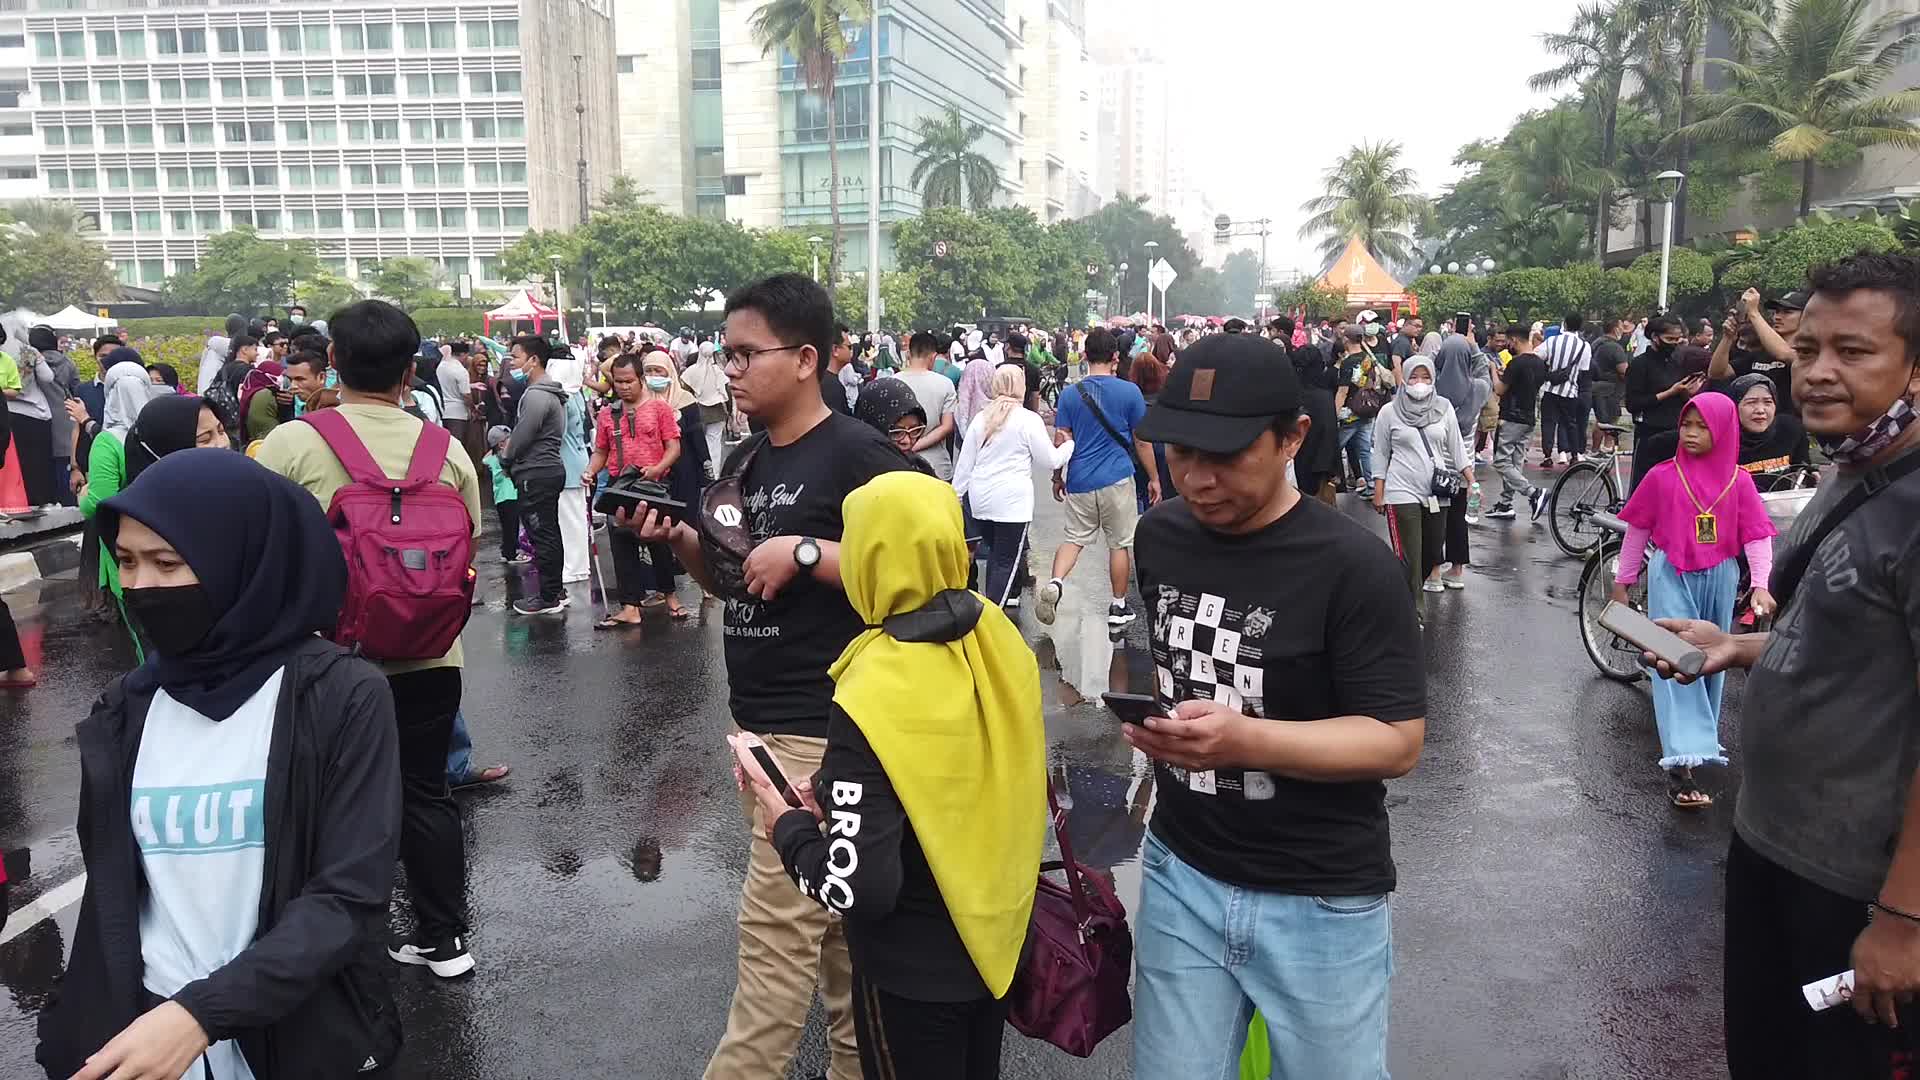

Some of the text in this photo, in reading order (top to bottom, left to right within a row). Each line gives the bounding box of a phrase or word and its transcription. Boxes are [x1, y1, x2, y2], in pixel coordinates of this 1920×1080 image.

[820, 175, 863, 188] ZRA
[769, 483, 804, 509] Soul
[819, 780, 863, 916] BROO
